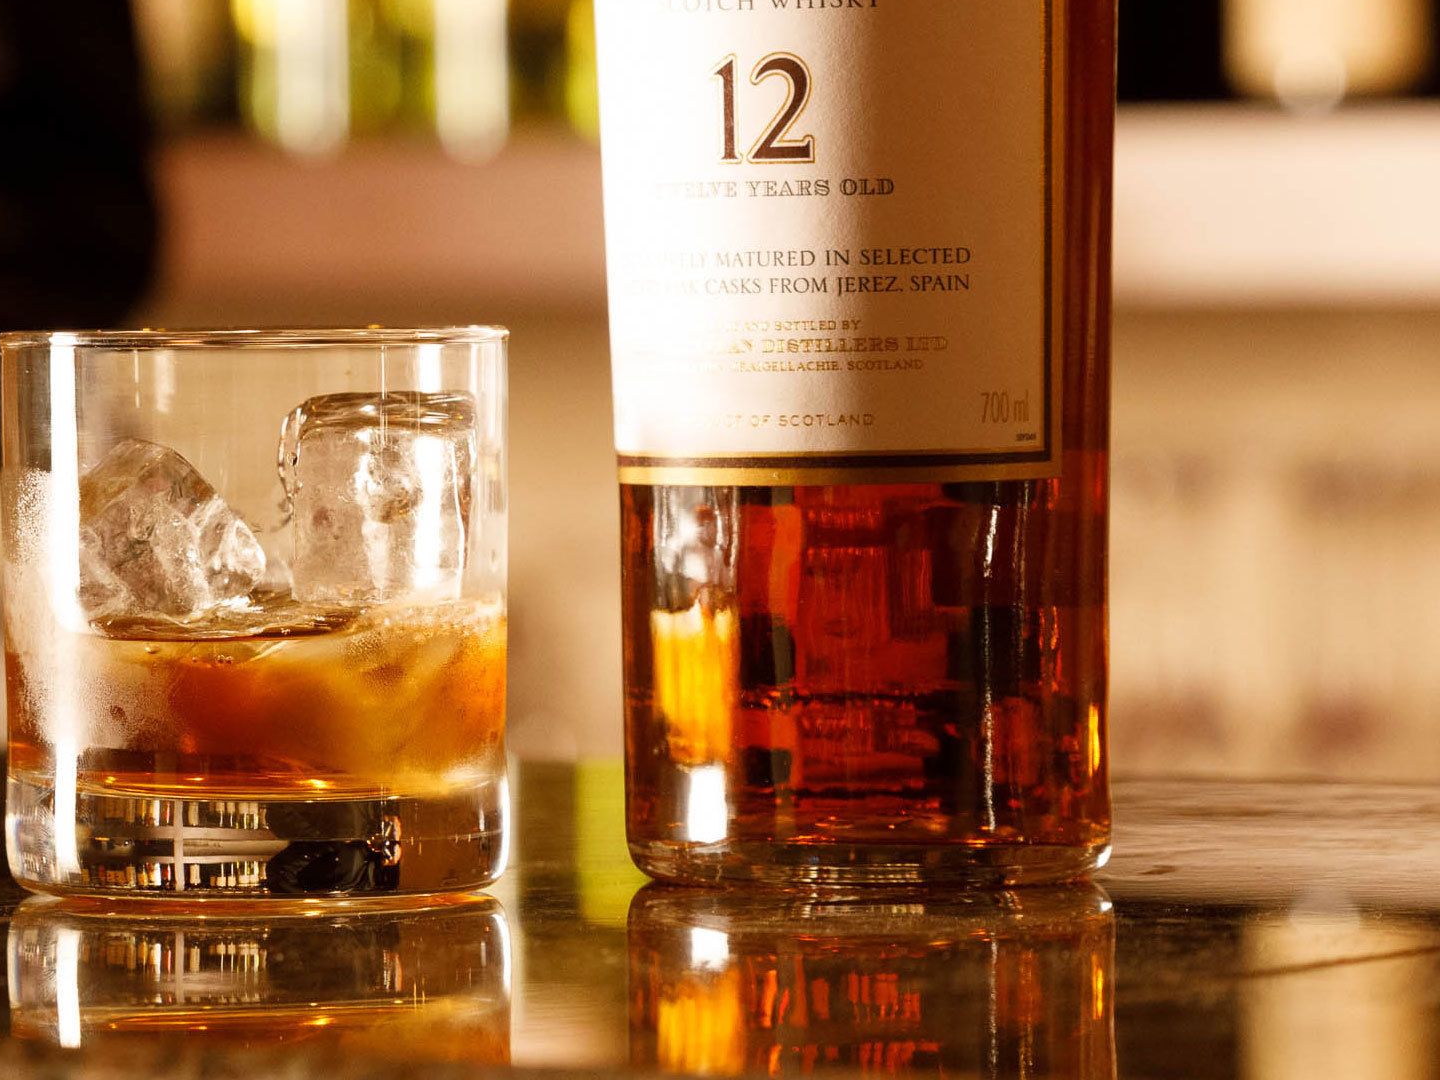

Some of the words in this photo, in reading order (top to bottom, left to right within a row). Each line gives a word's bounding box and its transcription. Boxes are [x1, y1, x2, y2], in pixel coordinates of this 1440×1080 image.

[711, 51, 815, 164] 12
[745, 179, 830, 198] YEARS
[840, 178, 894, 196] OLD
[716, 250, 816, 268] MATURED
[826, 249, 850, 266] IN
[860, 247, 971, 266] SELECTED
[704, 278, 761, 295] CASKS
[770, 277, 828, 294] FROM
[910, 274, 970, 292] SPAIN
[842, 319, 861, 331] BY
[762, 337, 899, 353] DISTILLERS
[905, 336, 948, 352] LTD
[847, 359, 924, 371] SCOTLAND
[980, 391, 1010, 423] 700
[1013, 389, 1030, 422] ml
[778, 413, 874, 427] SCOTLAND
